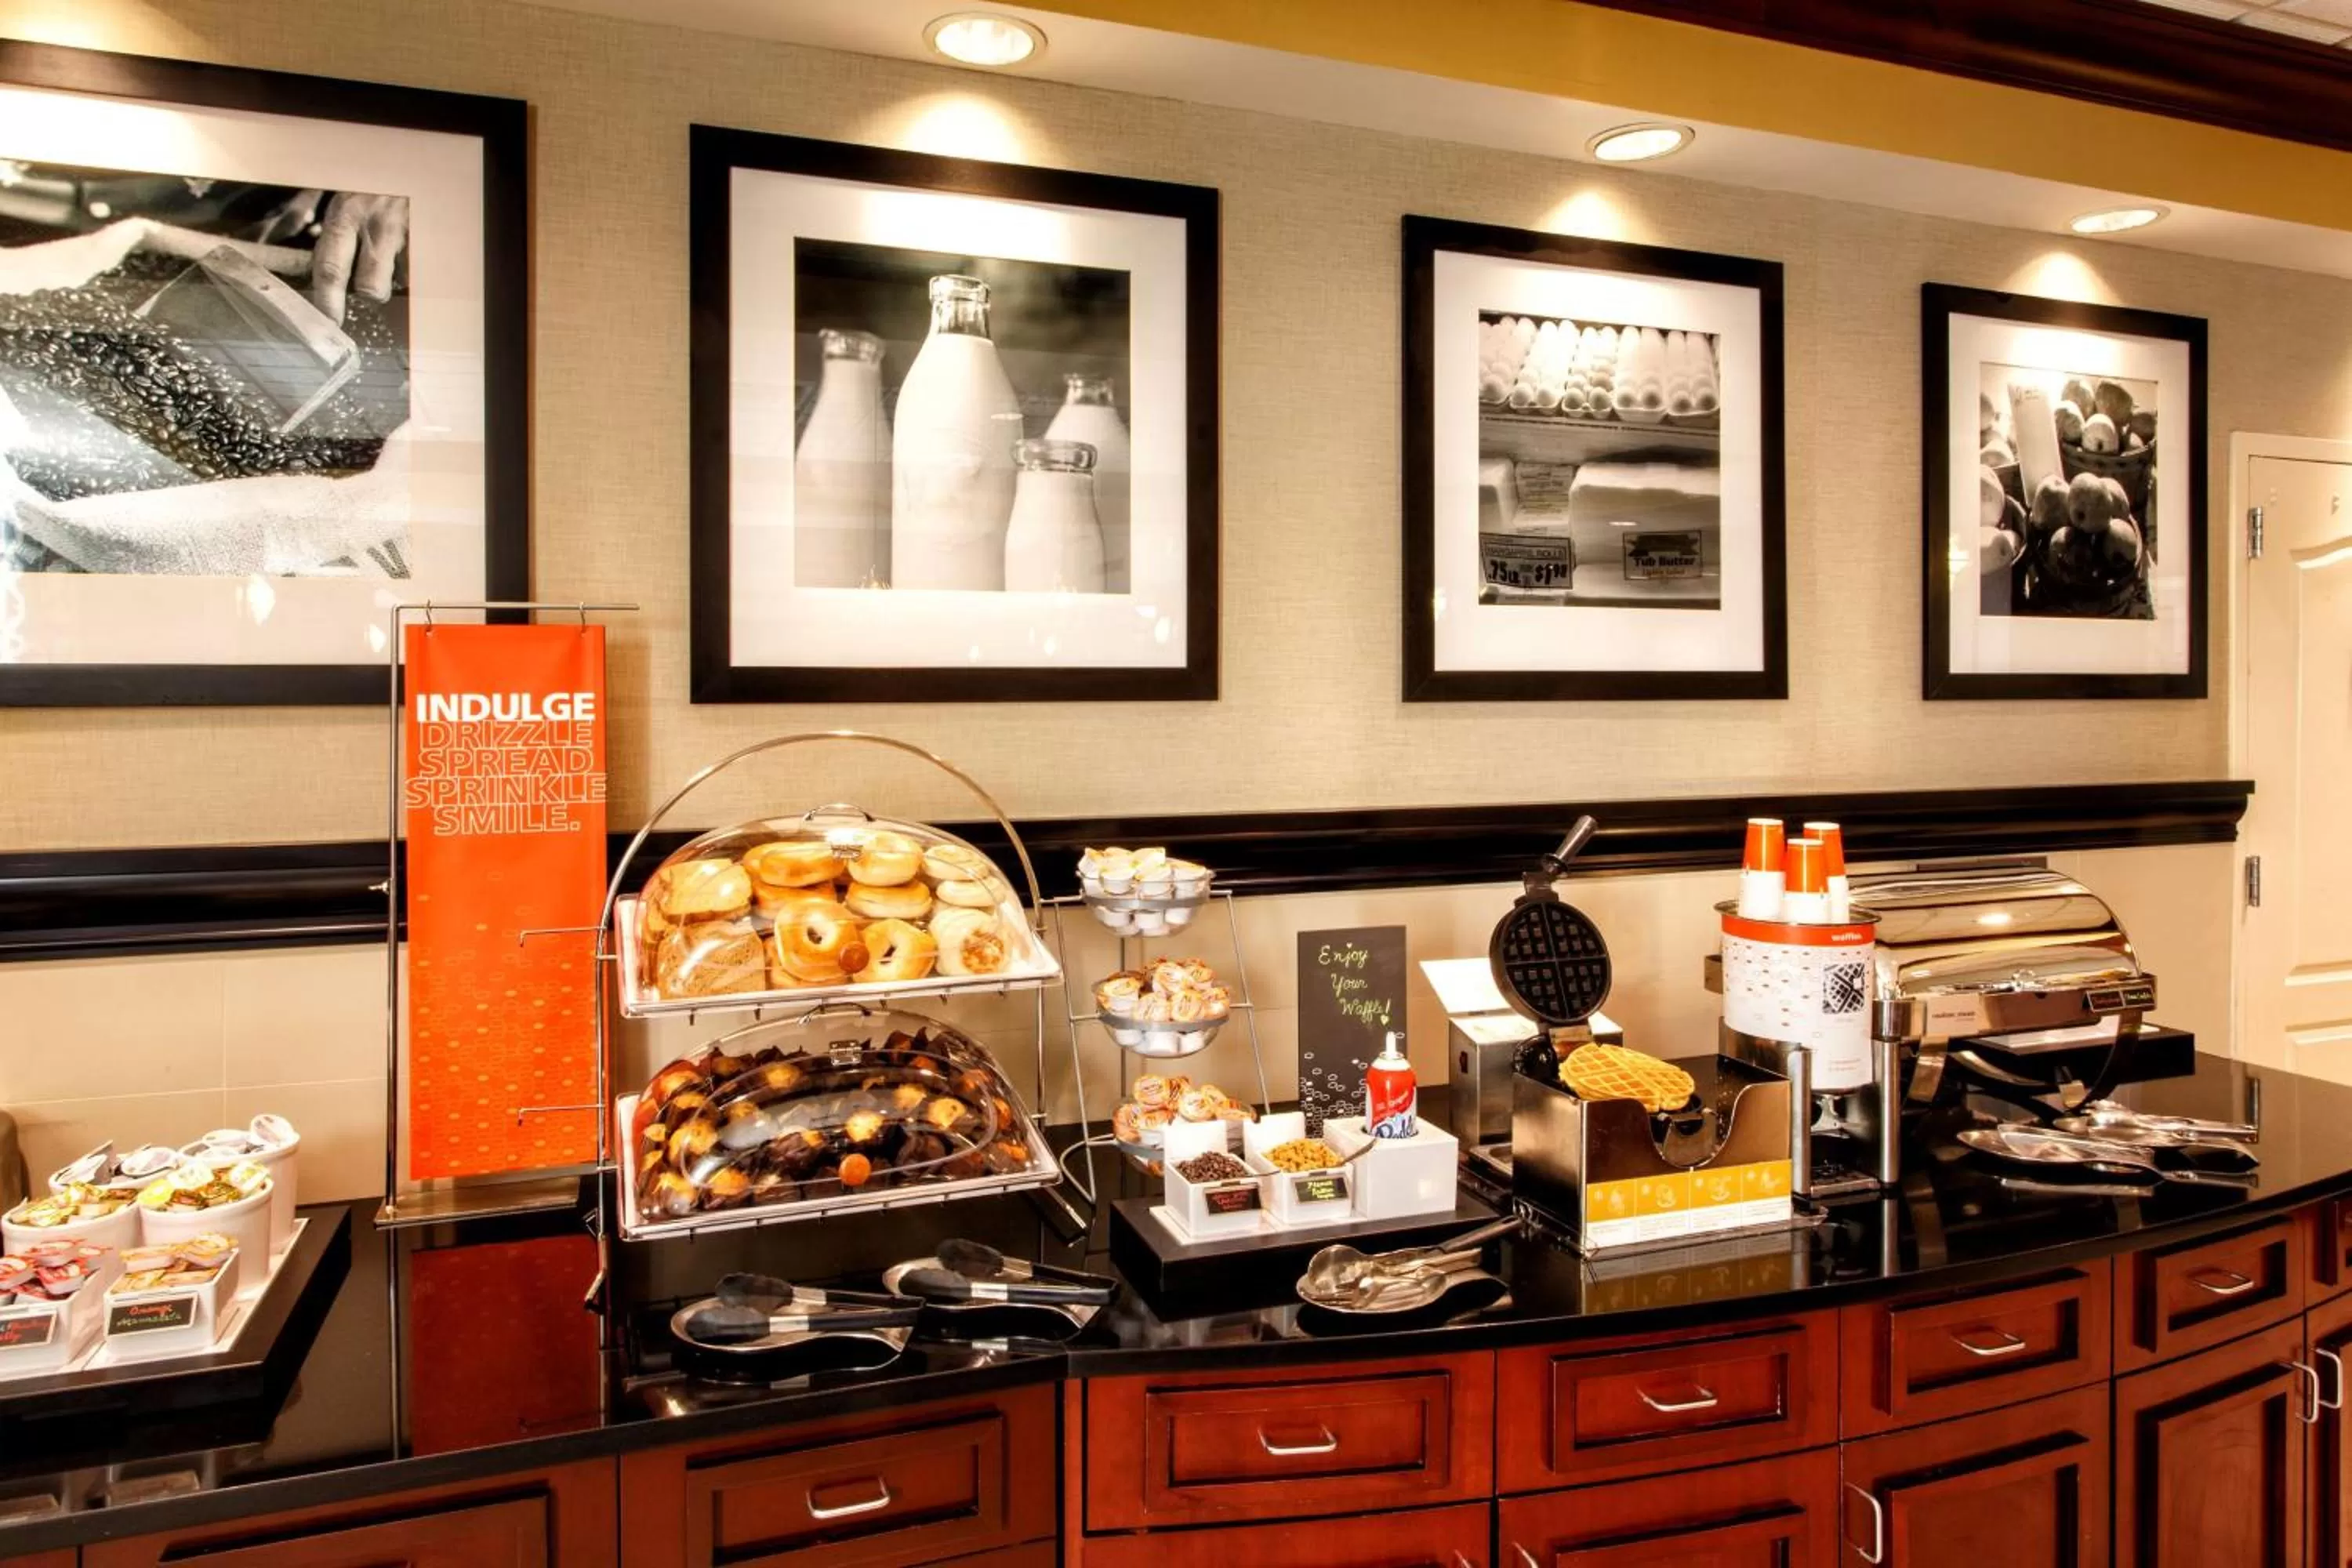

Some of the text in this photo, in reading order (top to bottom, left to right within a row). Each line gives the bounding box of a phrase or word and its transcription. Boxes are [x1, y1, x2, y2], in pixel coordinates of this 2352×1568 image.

[1659, 555, 1696, 566] Butter
[416, 692, 596, 723] INDULGE
[419, 719, 593, 750] DRIZZLE
[419, 746, 594, 779] SPREAD
[405, 772, 608, 808] SPRINKLE
[434, 803, 582, 837] SMILE.
[1318, 942, 1368, 969] Enjoy
[1330, 973, 1368, 997] Your
